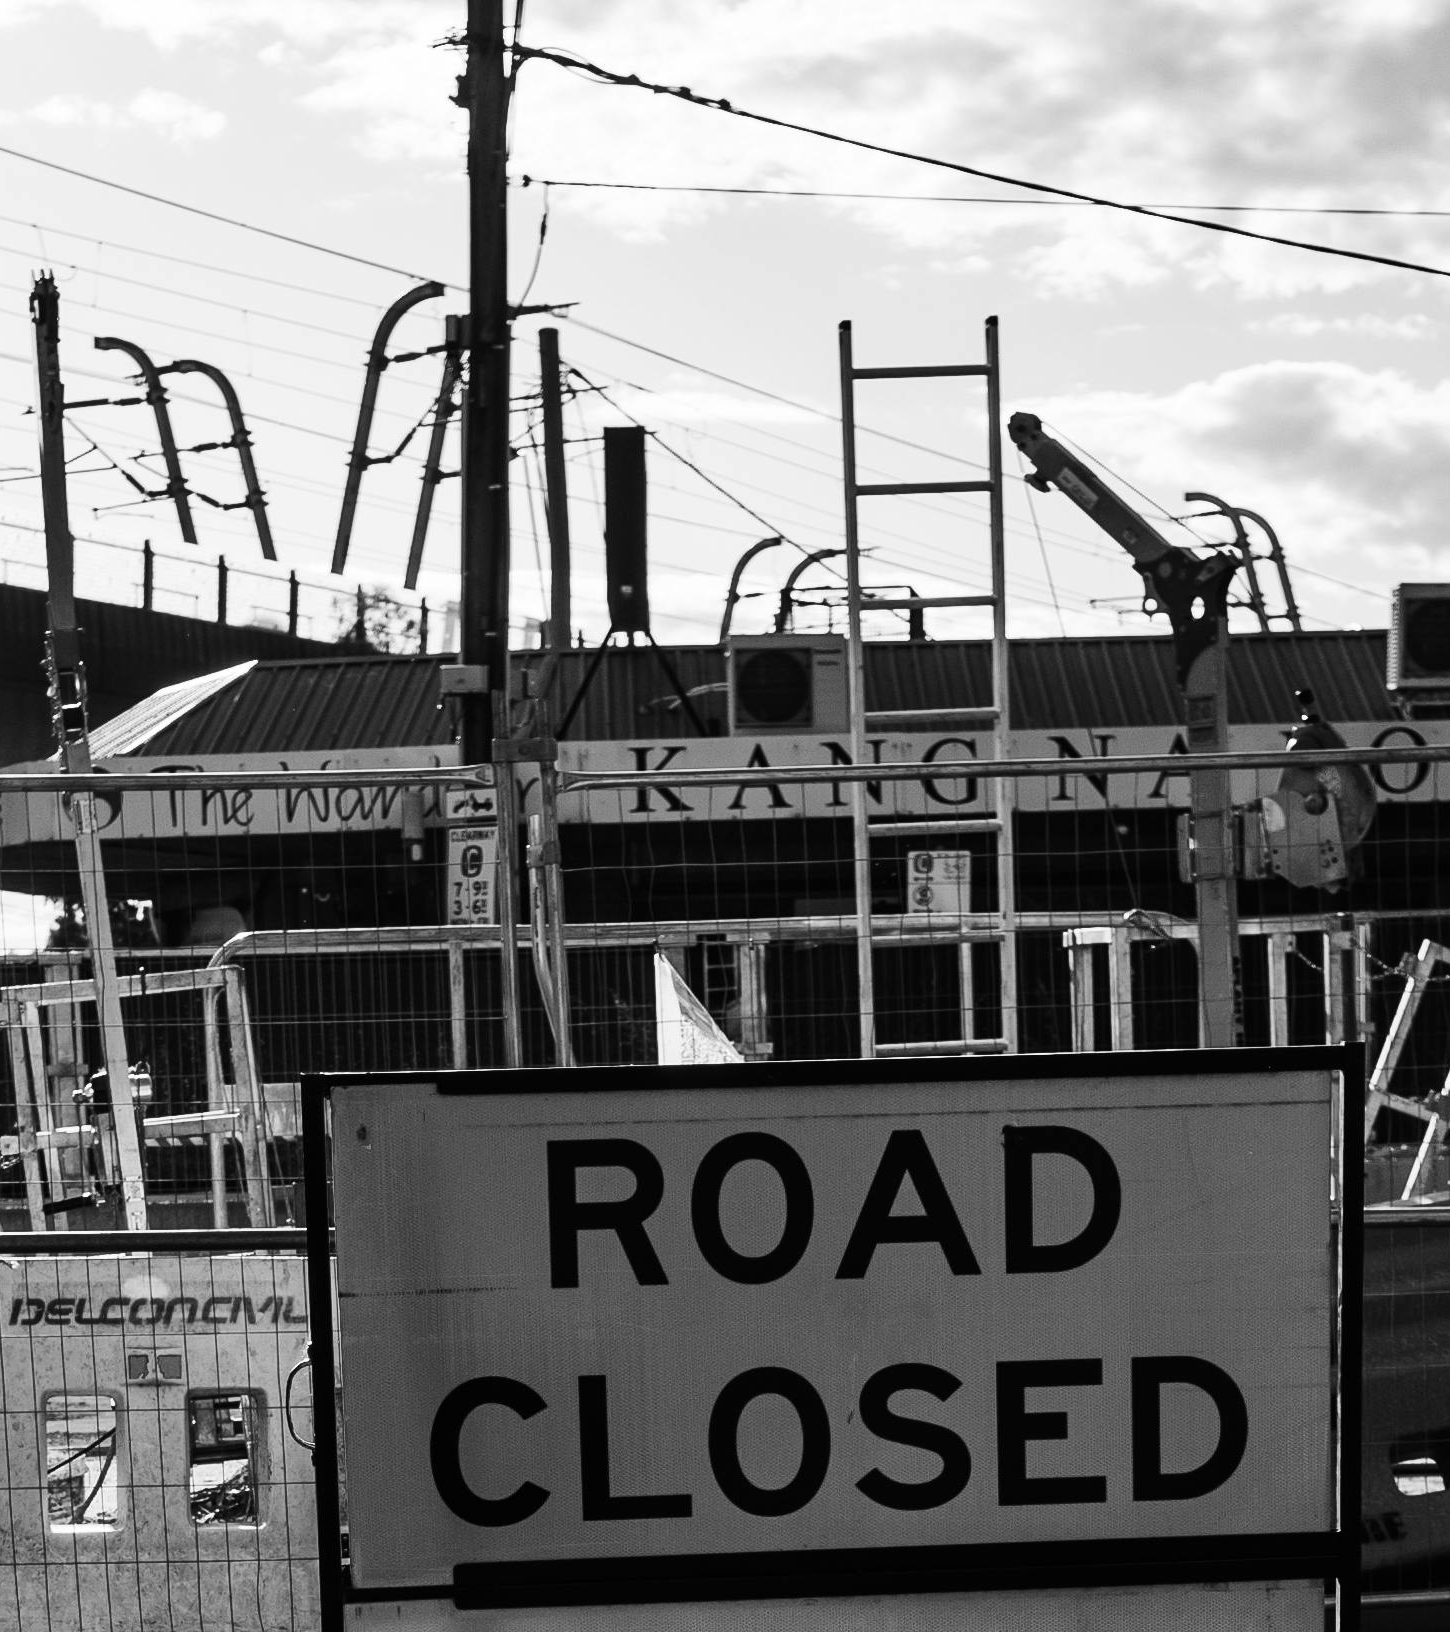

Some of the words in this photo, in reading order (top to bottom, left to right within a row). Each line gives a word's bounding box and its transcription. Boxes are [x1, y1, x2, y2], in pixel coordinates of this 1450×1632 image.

[147, 763, 254, 827] The
[627, 737, 980, 813] KANG
[547, 1125, 1122, 1289] ROAD
[429, 1354, 1249, 1527] CLOSED
